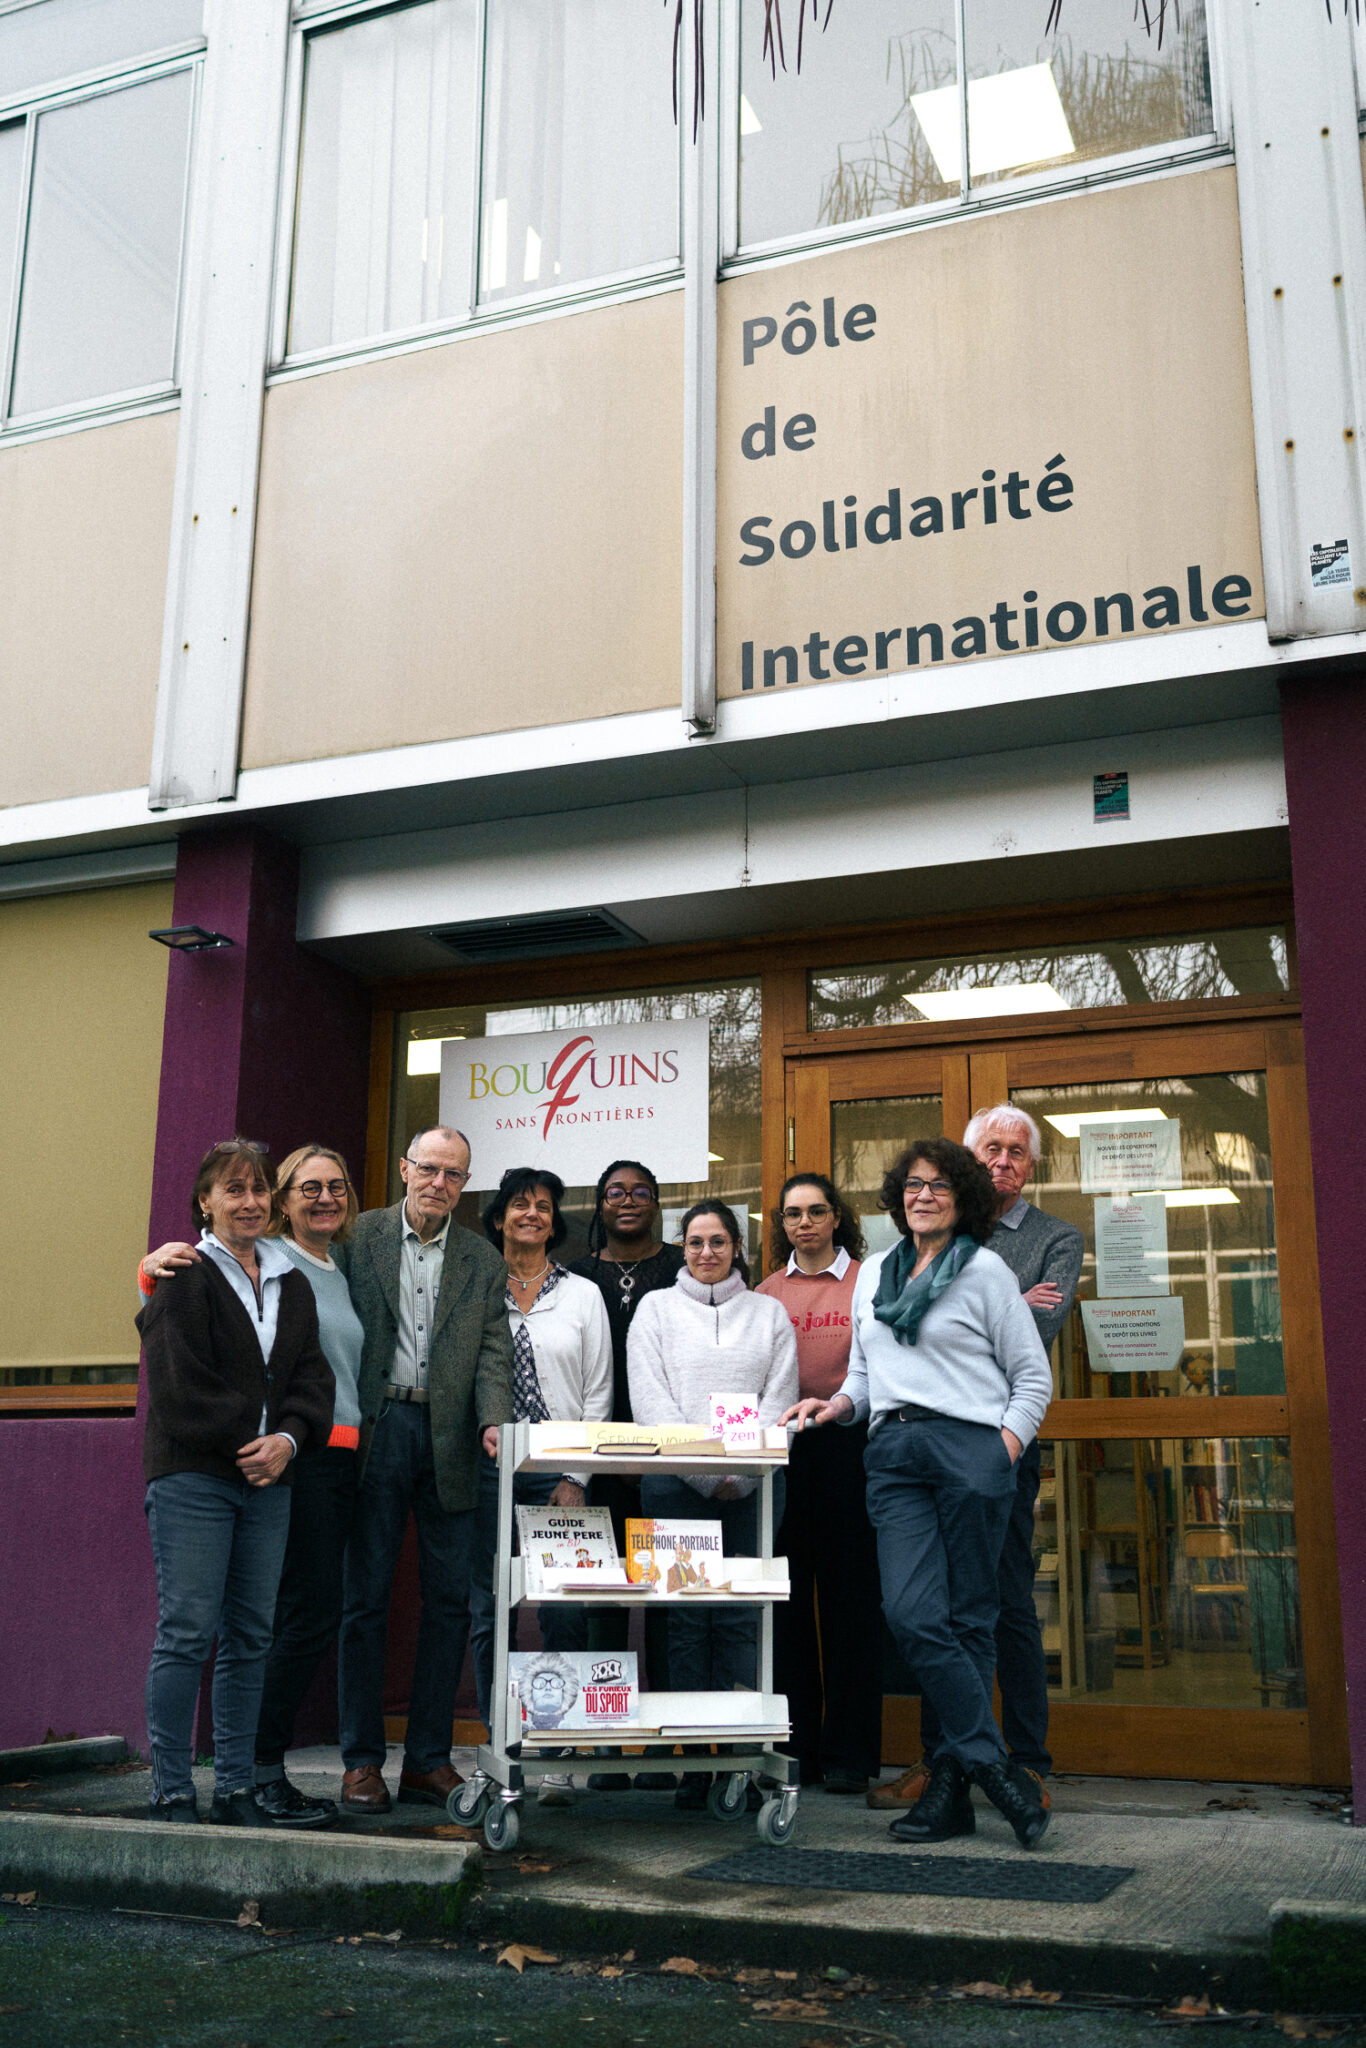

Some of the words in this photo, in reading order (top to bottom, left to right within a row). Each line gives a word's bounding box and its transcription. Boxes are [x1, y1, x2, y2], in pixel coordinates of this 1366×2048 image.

[742, 296, 877, 366] Pôle
[740, 405, 817, 461] de
[738, 453, 1074, 567] Solidarité
[741, 565, 1253, 691] Internationale
[495, 1115, 537, 1131] SANS
[1109, 1131, 1153, 1140] IMPORTANT
[801, 1310, 850, 1332] jolie
[1111, 1308, 1157, 1318] IMPORTANT
[730, 1431, 756, 1442] zen
[548, 1518, 585, 1528] GUIDE
[531, 1530, 570, 1540] JEUNE
[679, 1534, 720, 1551] PORTABLE
[592, 1659, 622, 1683] XXI
[586, 1693, 598, 1713] DU
[599, 1693, 629, 1713] SPORT
